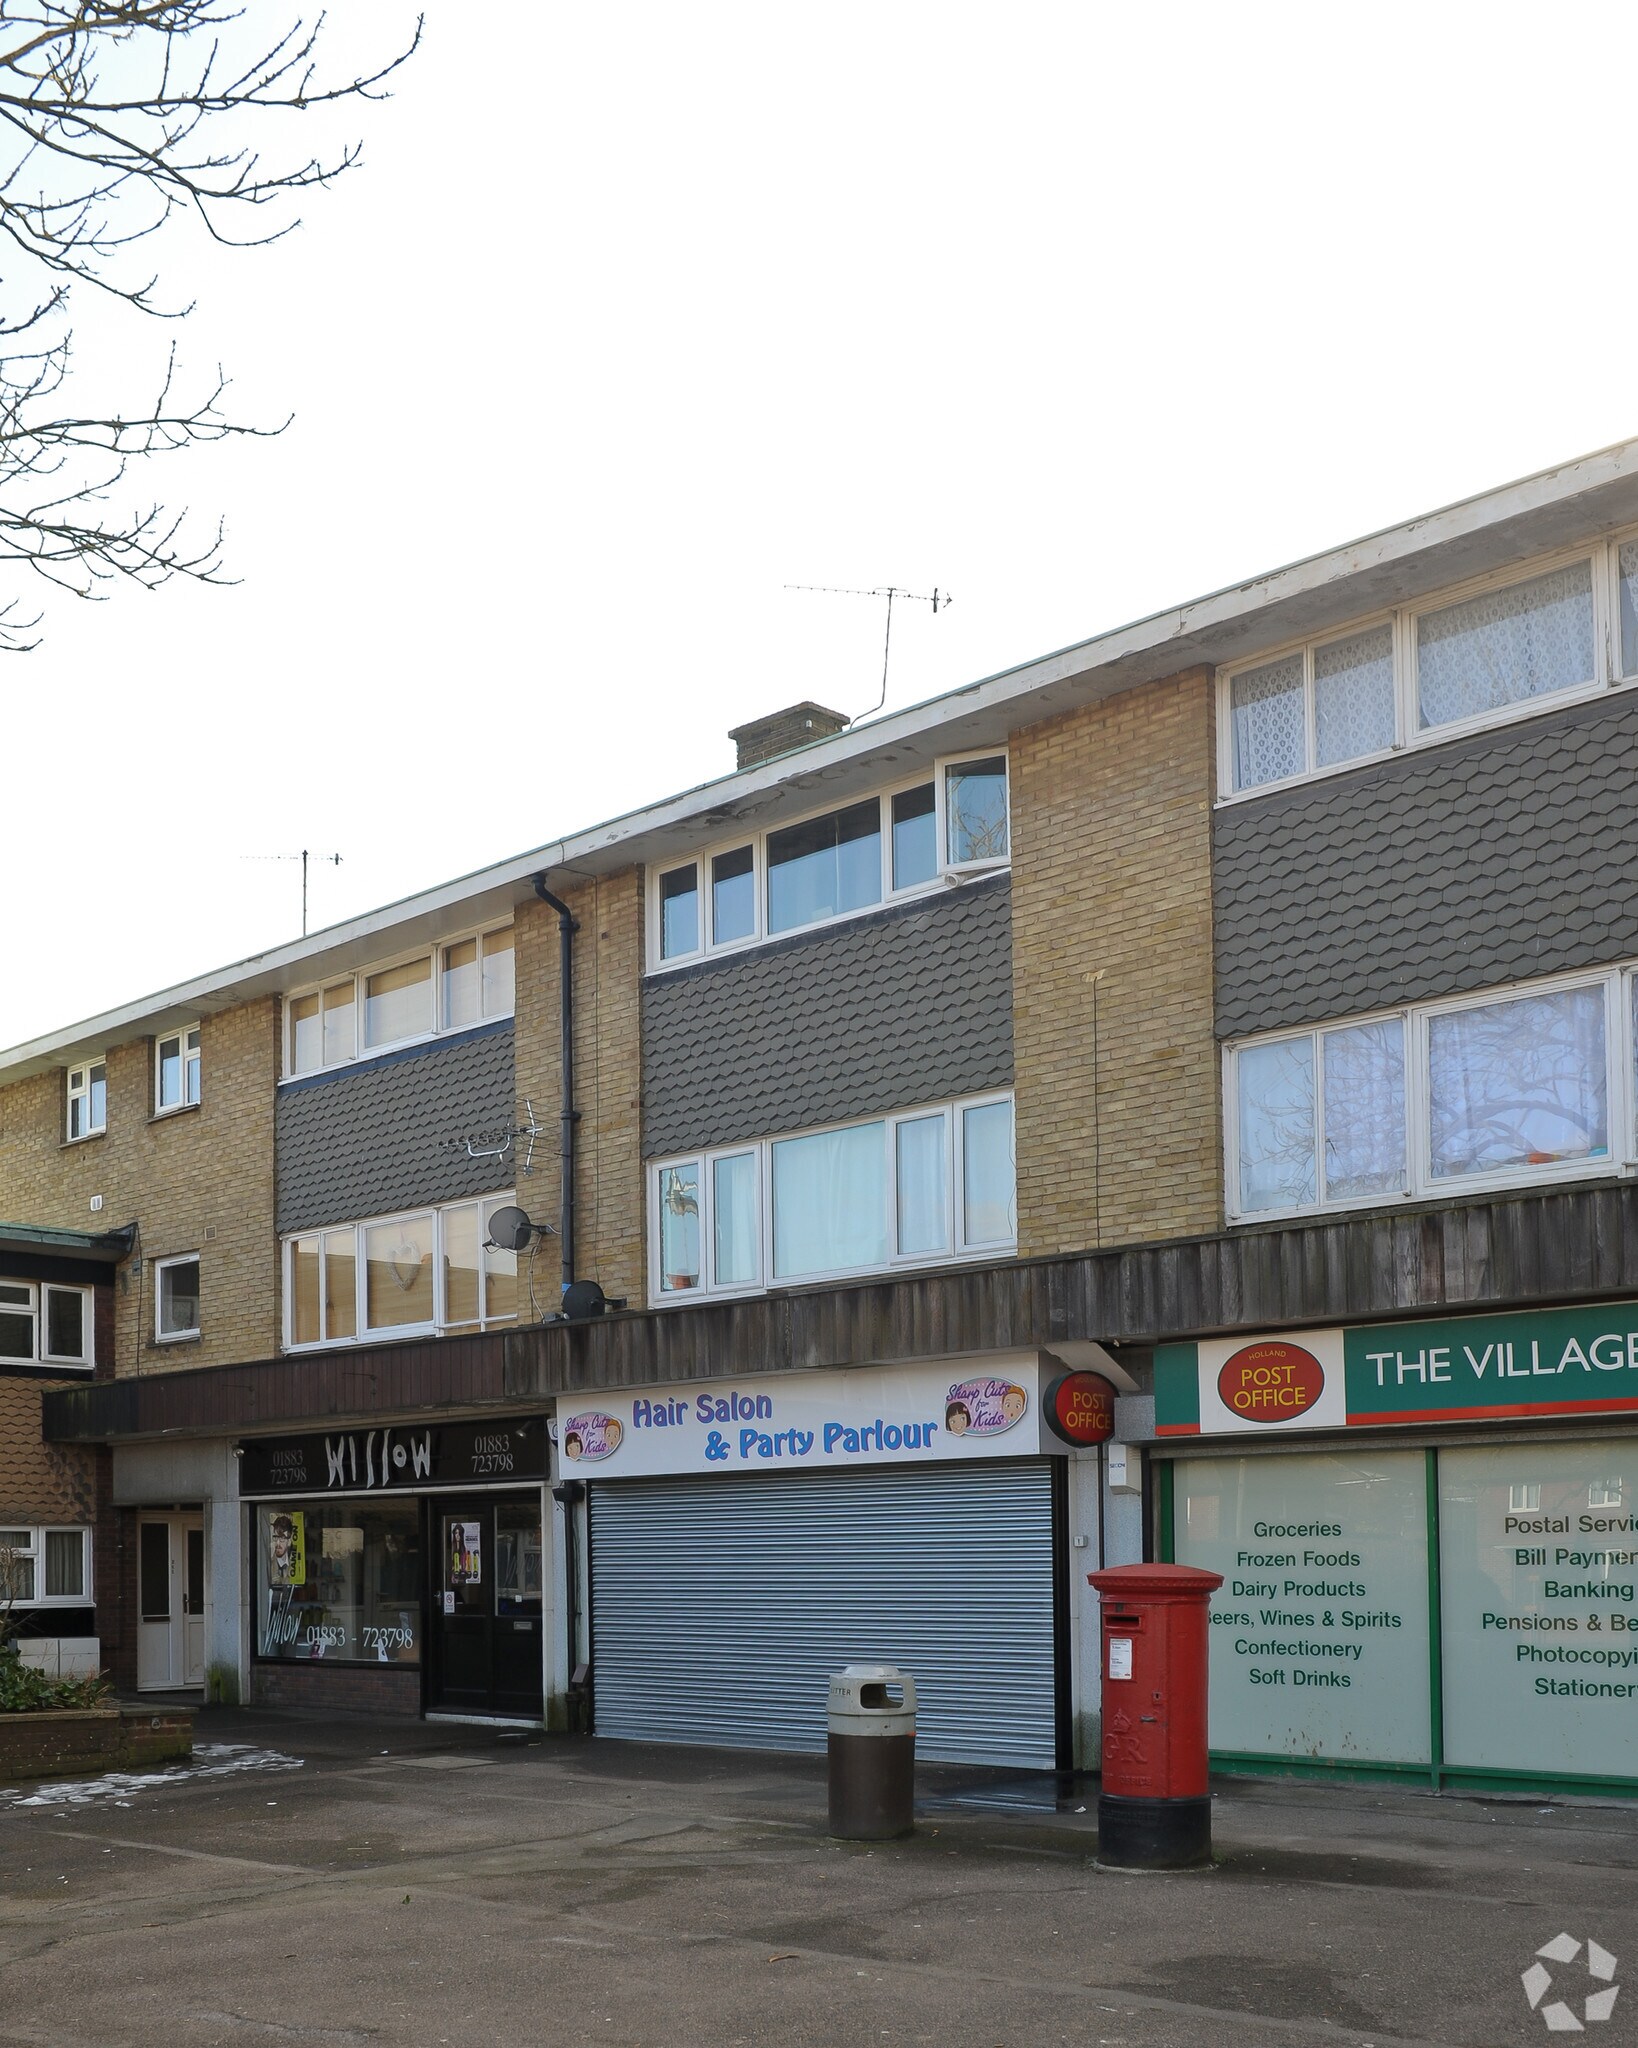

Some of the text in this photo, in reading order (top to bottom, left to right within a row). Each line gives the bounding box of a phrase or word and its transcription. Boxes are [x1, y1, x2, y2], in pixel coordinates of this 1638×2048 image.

[1248, 1350, 1287, 1361] HOLLAND
[1365, 1332, 1638, 1386] THE VILLAGE
[1241, 1365, 1296, 1387] POST
[946, 1380, 1011, 1405] Sharp Cuts
[1072, 1391, 1106, 1409] POST
[1233, 1386, 1306, 1409] OFFICE
[632, 1391, 773, 1429] Hair Salon
[975, 1397, 990, 1412] for
[565, 1417, 588, 1435] Sharp
[973, 1408, 1005, 1428] Kids
[1065, 1410, 1111, 1430] OFFICE
[474, 1434, 510, 1454] 01883
[584, 1439, 607, 1455] Kids
[704, 1419, 938, 1461] & Party Parlour
[272, 1450, 304, 1467] 01883
[471, 1453, 514, 1473] 723798
[270, 1467, 307, 1485] 723798
[1253, 1521, 1342, 1538] Groceries
[1504, 1514, 1638, 1534] Postal Servi
[1237, 1550, 1361, 1567] Frozen Foods
[1515, 1548, 1546, 1566] Bill
[1232, 1580, 1366, 1600] Dairy Products
[1544, 1580, 1634, 1602] Banking
[1259, 1609, 1315, 1626] Wines
[1321, 1610, 1335, 1627] &
[1341, 1610, 1402, 1630] Spirits
[1482, 1612, 1638, 1632] Pensions & Be
[306, 1625, 346, 1647] 01883
[362, 1627, 414, 1649] 723798
[1234, 1638, 1363, 1661] Confectionery
[1249, 1668, 1351, 1687] Soft Drinks
[1534, 1677, 1638, 1698] Stationer
